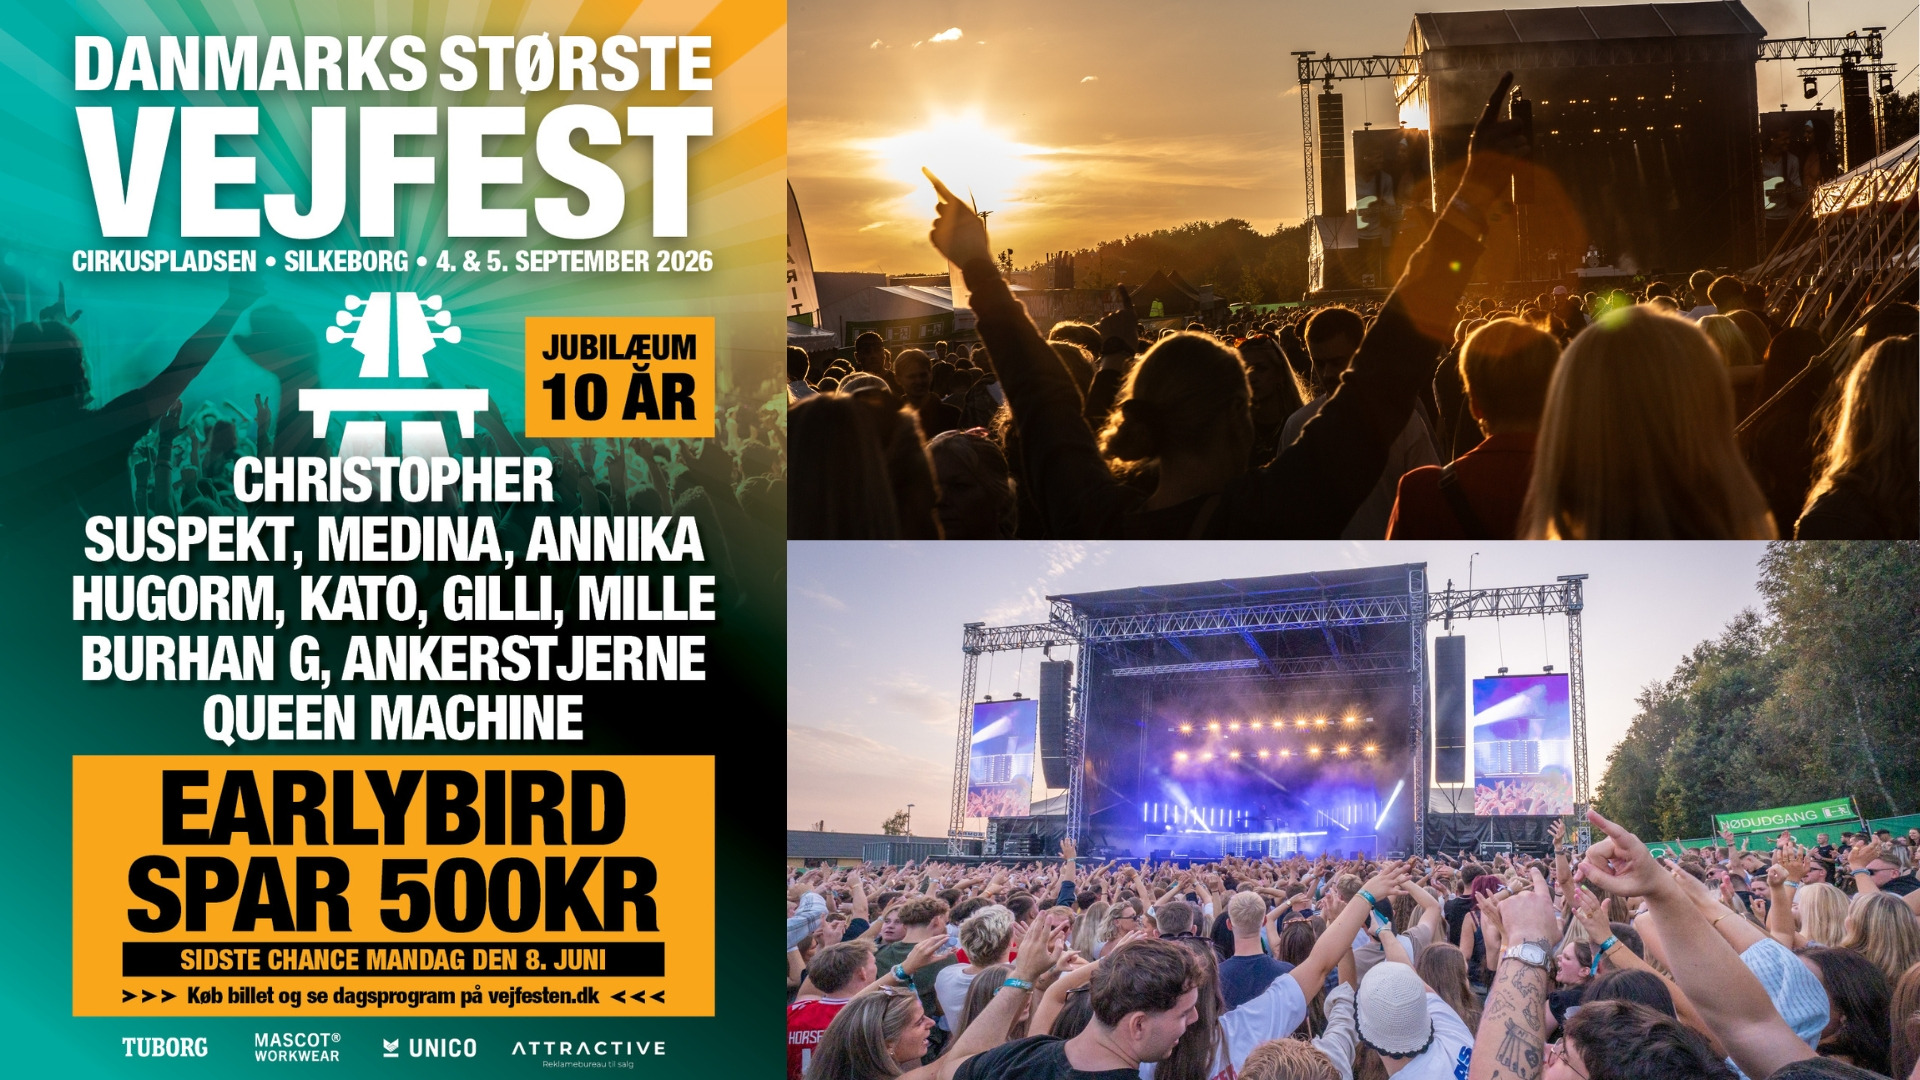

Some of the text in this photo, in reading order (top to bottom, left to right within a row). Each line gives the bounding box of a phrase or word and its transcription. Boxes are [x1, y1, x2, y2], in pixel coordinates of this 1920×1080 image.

[75, 32, 713, 95] DANMARKS STØRSTE
[76, 104, 713, 239] VEJFEST
[73, 250, 713, 272] CIRKUSPLADSEN SILKEBORG 4. & 5. SEPTEMBER 2026
[542, 334, 696, 360] JUBILÆUM
[543, 373, 607, 421] 10
[233, 456, 554, 503] CHRISTOPHER
[84, 515, 705, 569] SUSPEKT, MEDINA, ANNIKA
[73, 575, 716, 629] HUGORM, KATO, GILLI, MILLE
[82, 635, 706, 690] BURHAN G, ANKERSTJERNE
[203, 694, 584, 747] QUEEN MACHINE
[162, 770, 626, 845] EARLYBIRD
[1718, 810, 1818, 831] NØDUDGANG
[127, 855, 660, 934] SPAR 500KR
[180, 949, 606, 971] SIDSTE CHANCE MANDAG DEN 8. JUNI
[187, 985, 600, 1008] Køb billet og se dagsprogram på vejfesten.dk
[122, 1037, 208, 1058] TUBORG
[254, 1049, 340, 1062] WORKWEAR
[410, 1038, 477, 1058] UNICO
[511, 1041, 666, 1056] ATTRACTIVE
[542, 1060, 634, 1070] Reklamebureau til salg
